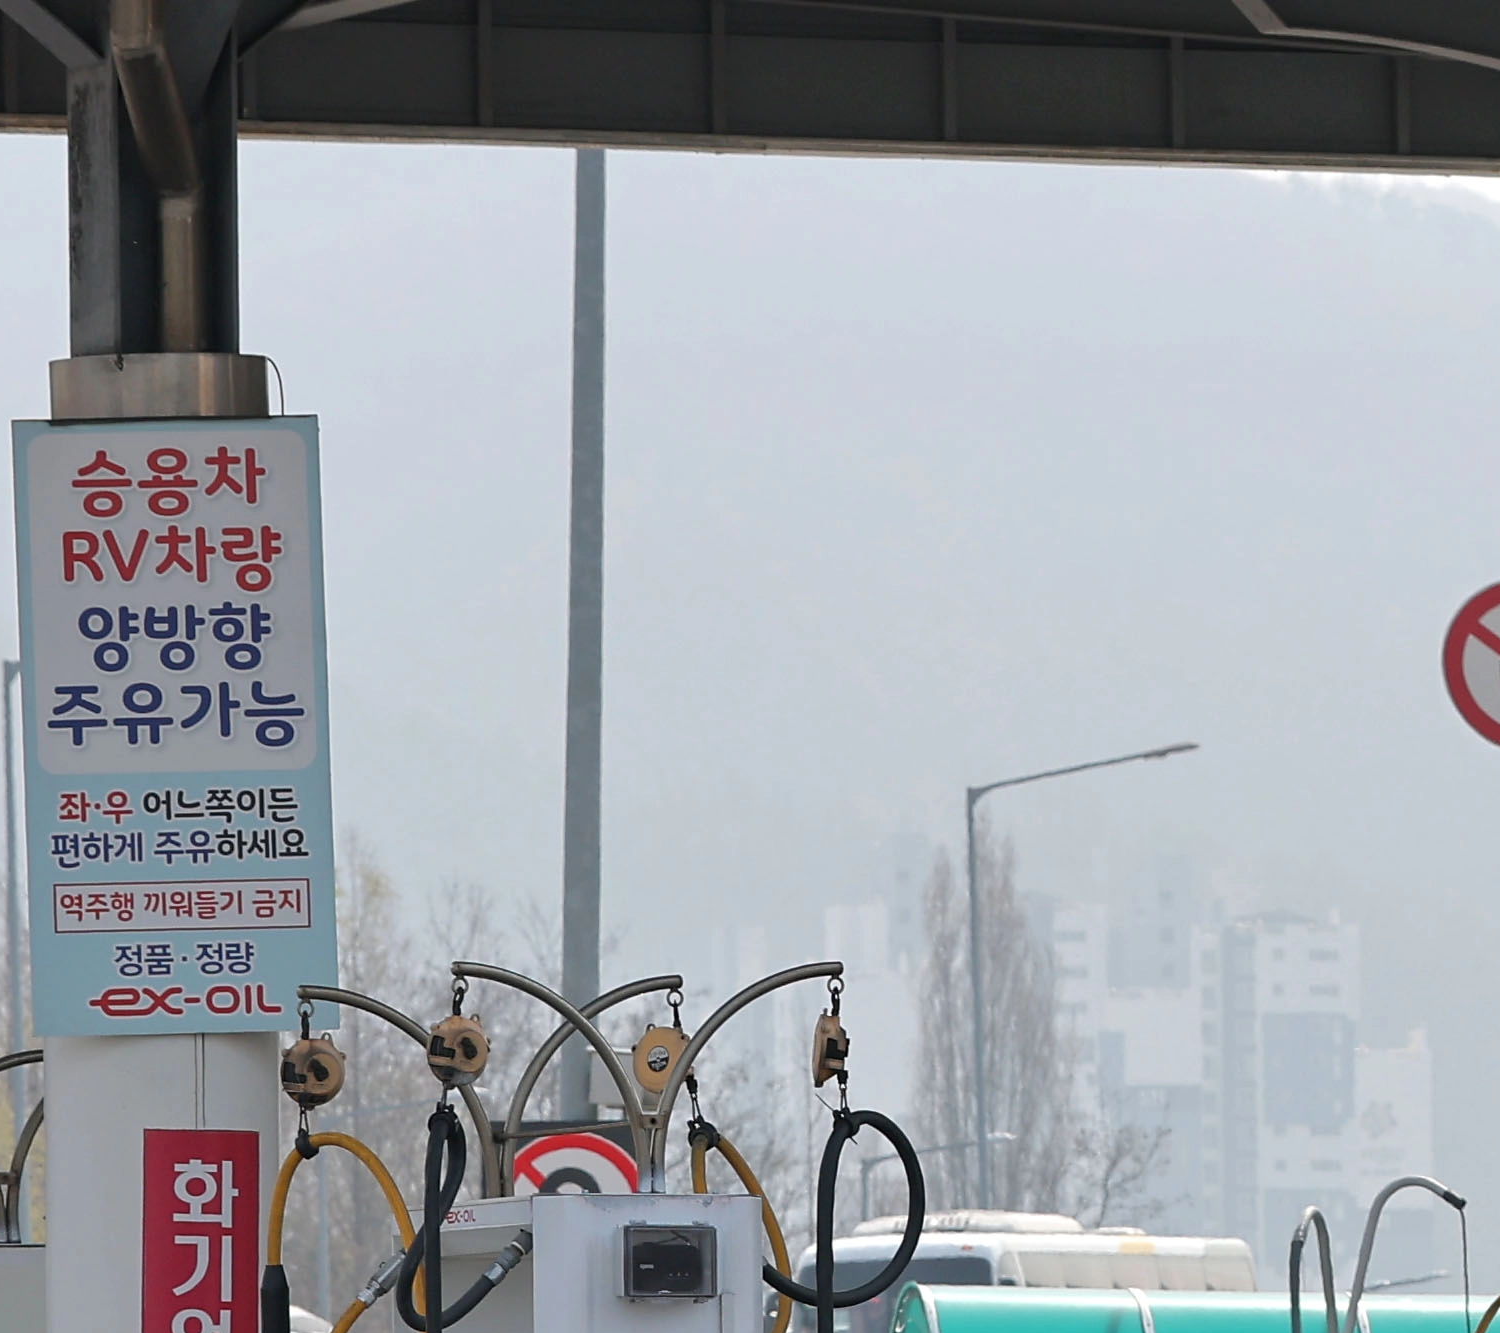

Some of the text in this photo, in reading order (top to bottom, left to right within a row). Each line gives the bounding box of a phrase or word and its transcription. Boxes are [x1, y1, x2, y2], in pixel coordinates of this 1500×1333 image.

[71, 445, 267, 519] 승용차
[61, 523, 284, 594] RV차량
[77, 601, 273, 674] 양방향
[46, 680, 307, 749] 주유가능
[58, 787, 299, 825] 좌·우 어느쪽이든
[50, 828, 311, 870] 편하게 주유하세요
[59, 889, 303, 925] 역주행 끼워들기 금지
